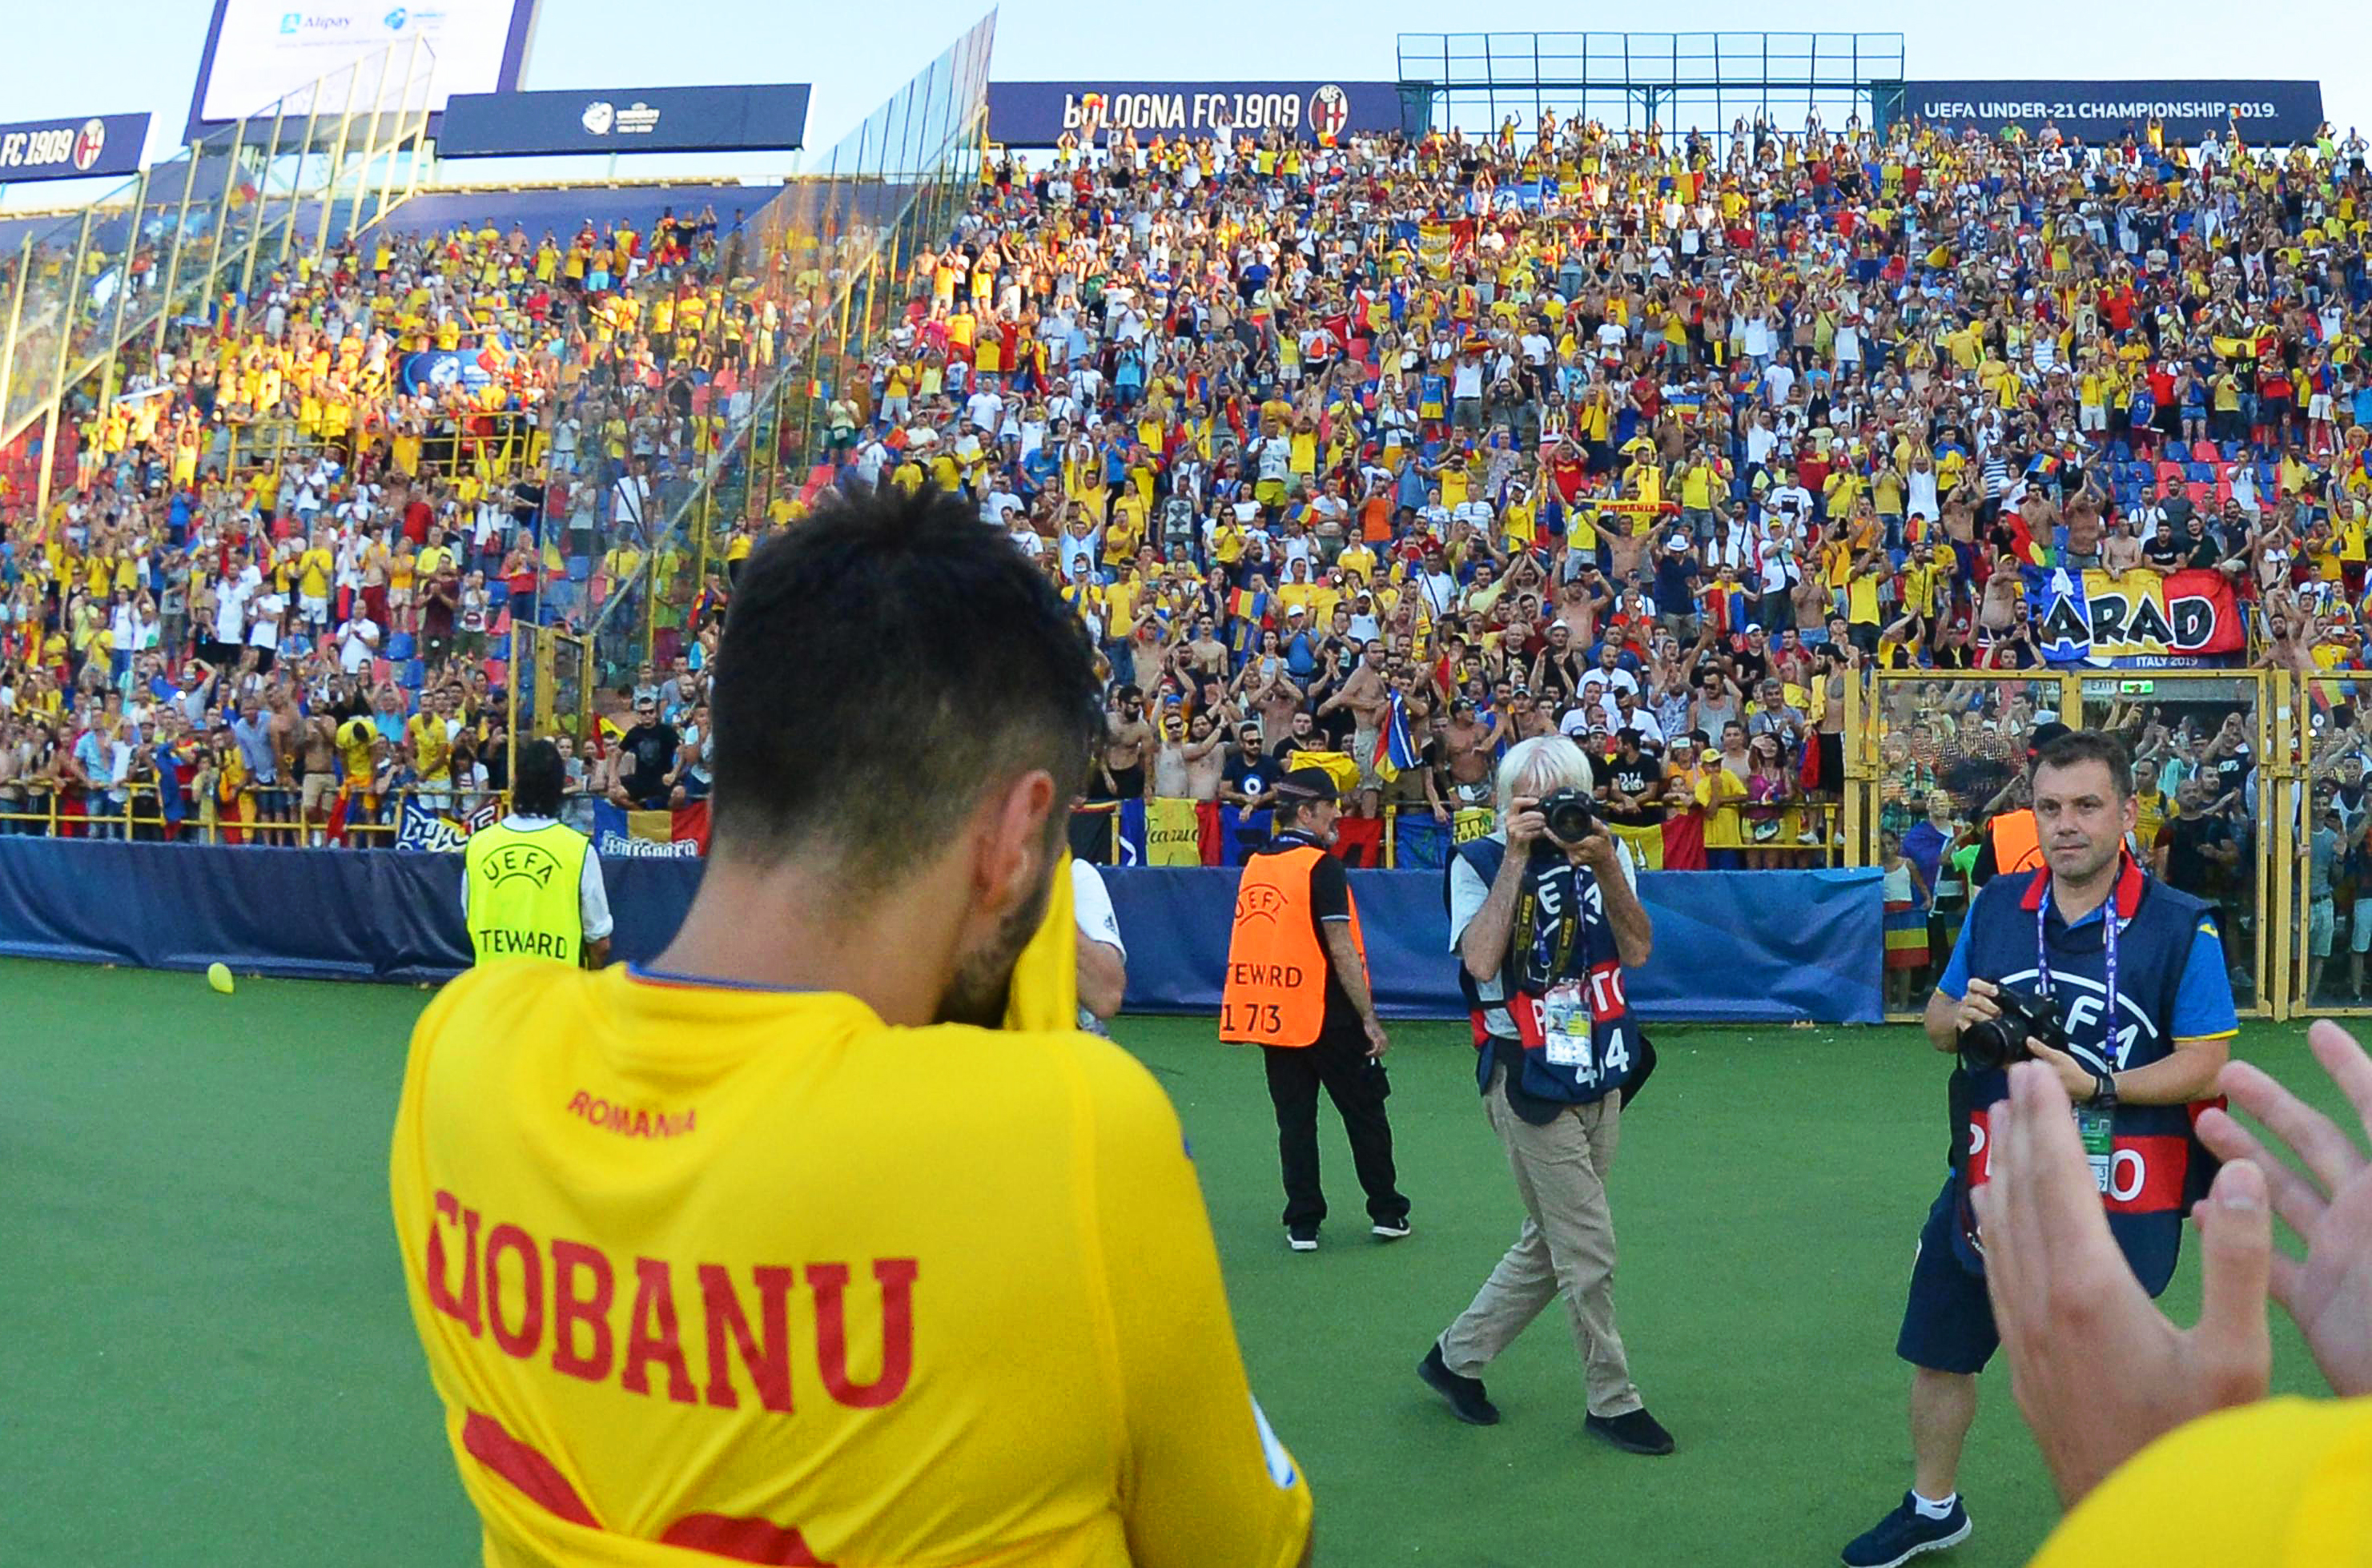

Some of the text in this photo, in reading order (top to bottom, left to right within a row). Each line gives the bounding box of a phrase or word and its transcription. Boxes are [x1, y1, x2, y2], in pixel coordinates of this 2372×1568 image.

[1192, 93, 1228, 129] FC
[1232, 93, 1301, 129] 1909
[1924, 102, 1976, 119] UEFA
[1979, 102, 2077, 119] UNDER-21
[2078, 102, 2226, 119] CHAMPIONSHIP
[0, 128, 75, 167] FC 1909
[2040, 591, 2217, 652] ARAD
[2136, 657, 2199, 667] ITALY 2019
[483, 850, 553, 885] UEFA
[566, 1090, 697, 1140] ROMANIA
[426, 1188, 919, 1414] CIOBANU
